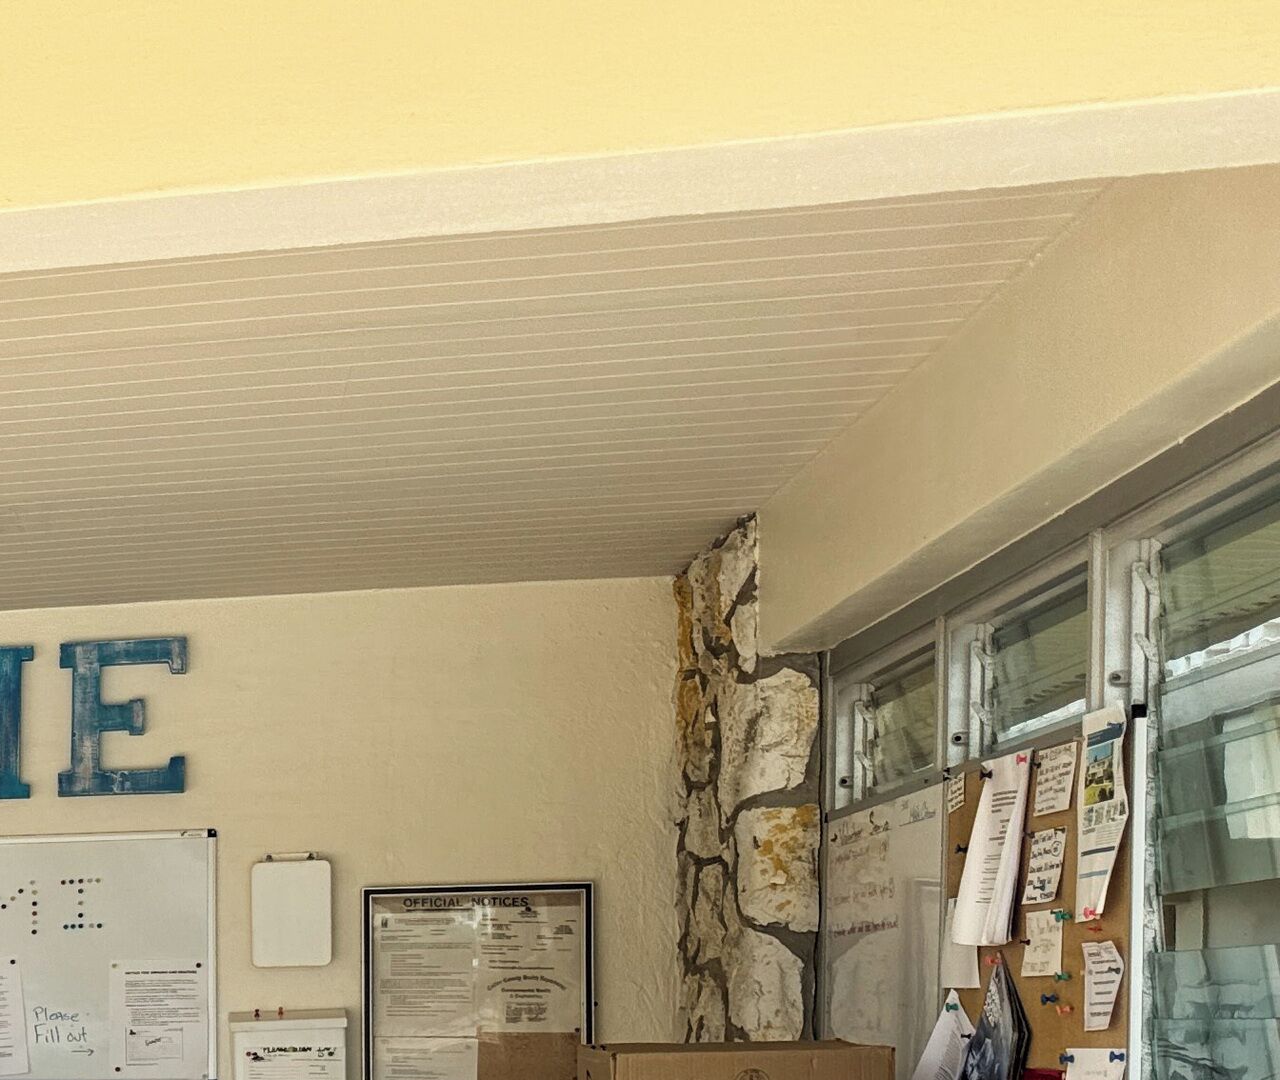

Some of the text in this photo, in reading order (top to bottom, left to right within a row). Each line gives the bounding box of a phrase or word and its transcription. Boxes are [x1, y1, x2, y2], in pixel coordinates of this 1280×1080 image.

[403, 897, 529, 908] OFFICIAL NOTICES
[33, 1007, 80, 1022] Please
[34, 1024, 88, 1043] Fill out
